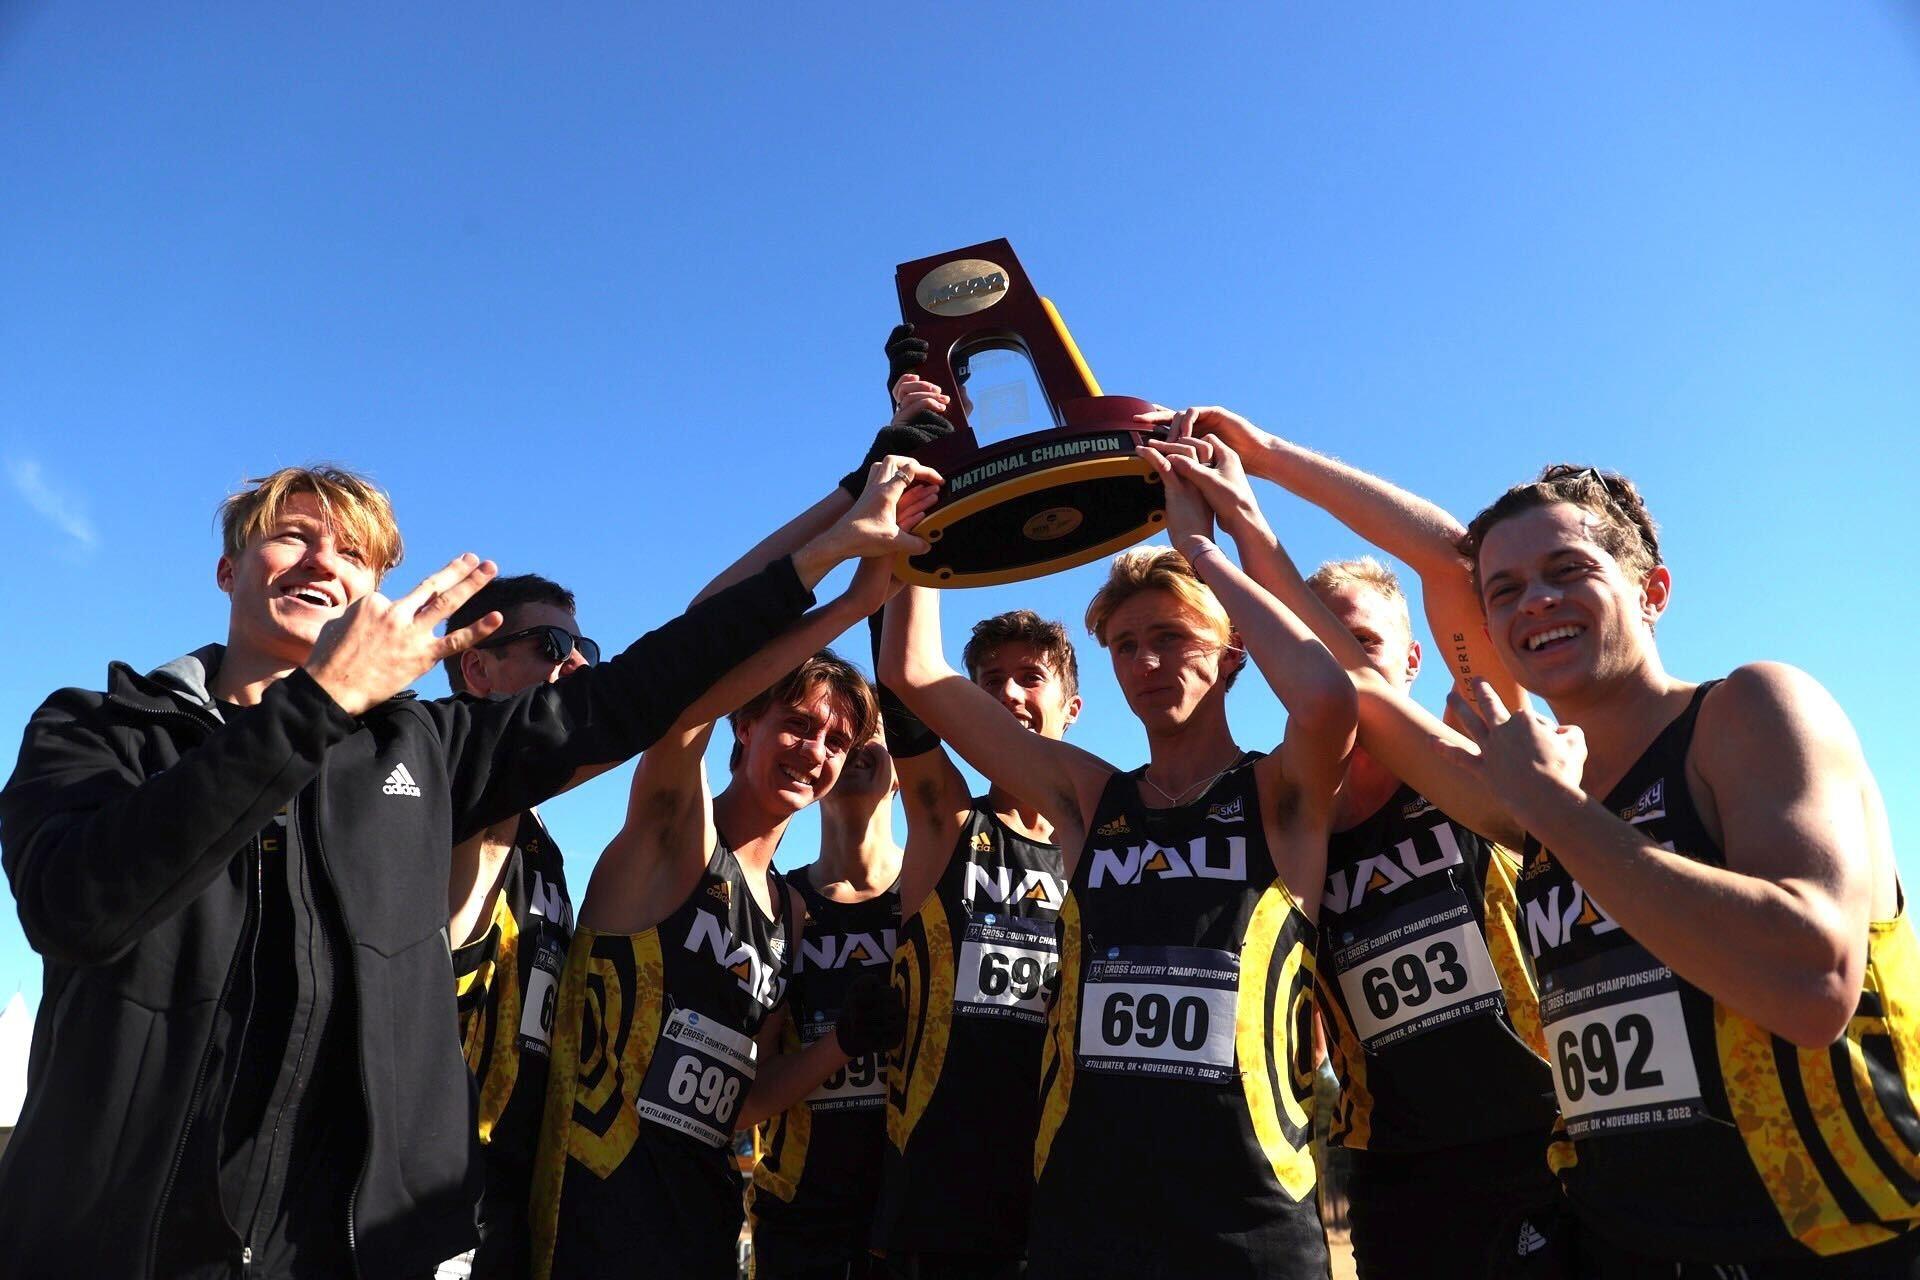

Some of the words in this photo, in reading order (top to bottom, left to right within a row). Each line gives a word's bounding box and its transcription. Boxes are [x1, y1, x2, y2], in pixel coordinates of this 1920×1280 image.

[951, 455, 1028, 492] NATIONAL
[1031, 437, 1120, 463] CHAMPION
[382, 783, 421, 797] adidas
[964, 862, 1068, 911] NA
[1088, 836, 1247, 889] NAU
[1320, 822, 1464, 914] NAU
[982, 928, 1005, 938] CROSS
[1006, 931, 1037, 942] COUNTRY
[1347, 942, 1369, 960] CROSS
[1370, 928, 1402, 949] COUNTRY
[1403, 905, 1469, 935] CHAMPIONSHIPS
[1526, 880, 1621, 959] NA
[1105, 965, 1130, 974] CROSS
[1130, 965, 1167, 975] COUNTRY
[1168, 966, 1238, 981] CHAMPIONSHIPS
[1362, 941, 1468, 1020] 693
[1565, 987, 1595, 1004] COUNTRY
[1596, 967, 1672, 995] CHAMPIONSHIPS
[682, 1028, 705, 1042] CROSS
[704, 1036, 729, 1054] COUNTRY
[1102, 992, 1209, 1051] 690
[1408, 1024, 1418, 1034] OK
[1421, 1008, 1462, 1028] NOVEMBER
[1475, 997, 1495, 1010] 2022
[1085, 1060, 1125, 1071] STILLWATER,
[1127, 1061, 1138, 1071] OK
[1142, 1063, 1184, 1075] NOVEMBER
[1185, 1067, 1195, 1077] 19,
[1198, 1068, 1220, 1079] 2022
[1557, 1013, 1664, 1102] 692
[668, 1055, 740, 1124] 698
[1591, 1119, 1601, 1130] OK
[1606, 1111, 1650, 1128] NOVEMBER
[1667, 1106, 1691, 1120] 2022
